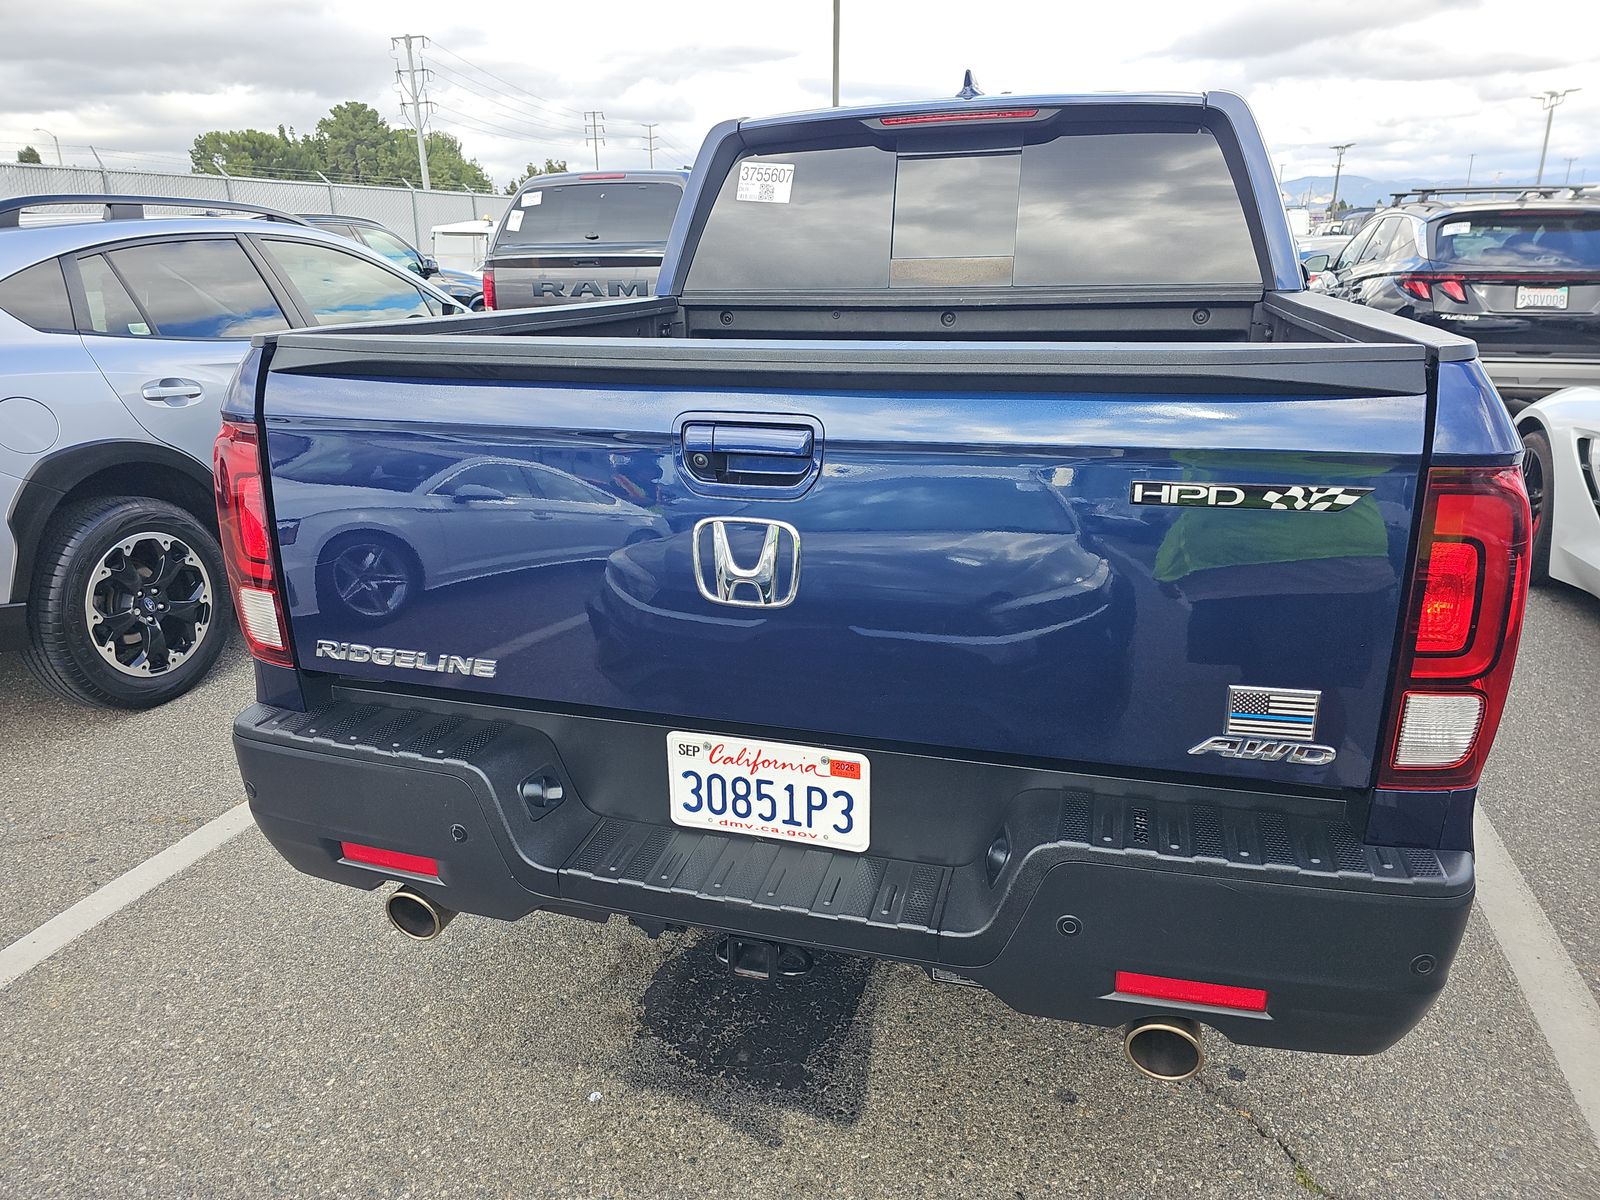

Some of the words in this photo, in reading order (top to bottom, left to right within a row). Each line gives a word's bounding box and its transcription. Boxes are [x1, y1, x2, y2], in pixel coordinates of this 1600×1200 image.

[742, 166, 793, 183] 3755607
[532, 279, 649, 297] RAM
[1133, 484, 1245, 506] HPD
[315, 639, 498, 678] RIDGELINE
[678, 743, 700, 757] SEP
[709, 744, 831, 777] California
[1187, 736, 1337, 766] AWD
[835, 762, 855, 772] 2026
[682, 770, 854, 834] 30851P3
[719, 819, 818, 840] dmv.ca.gov
